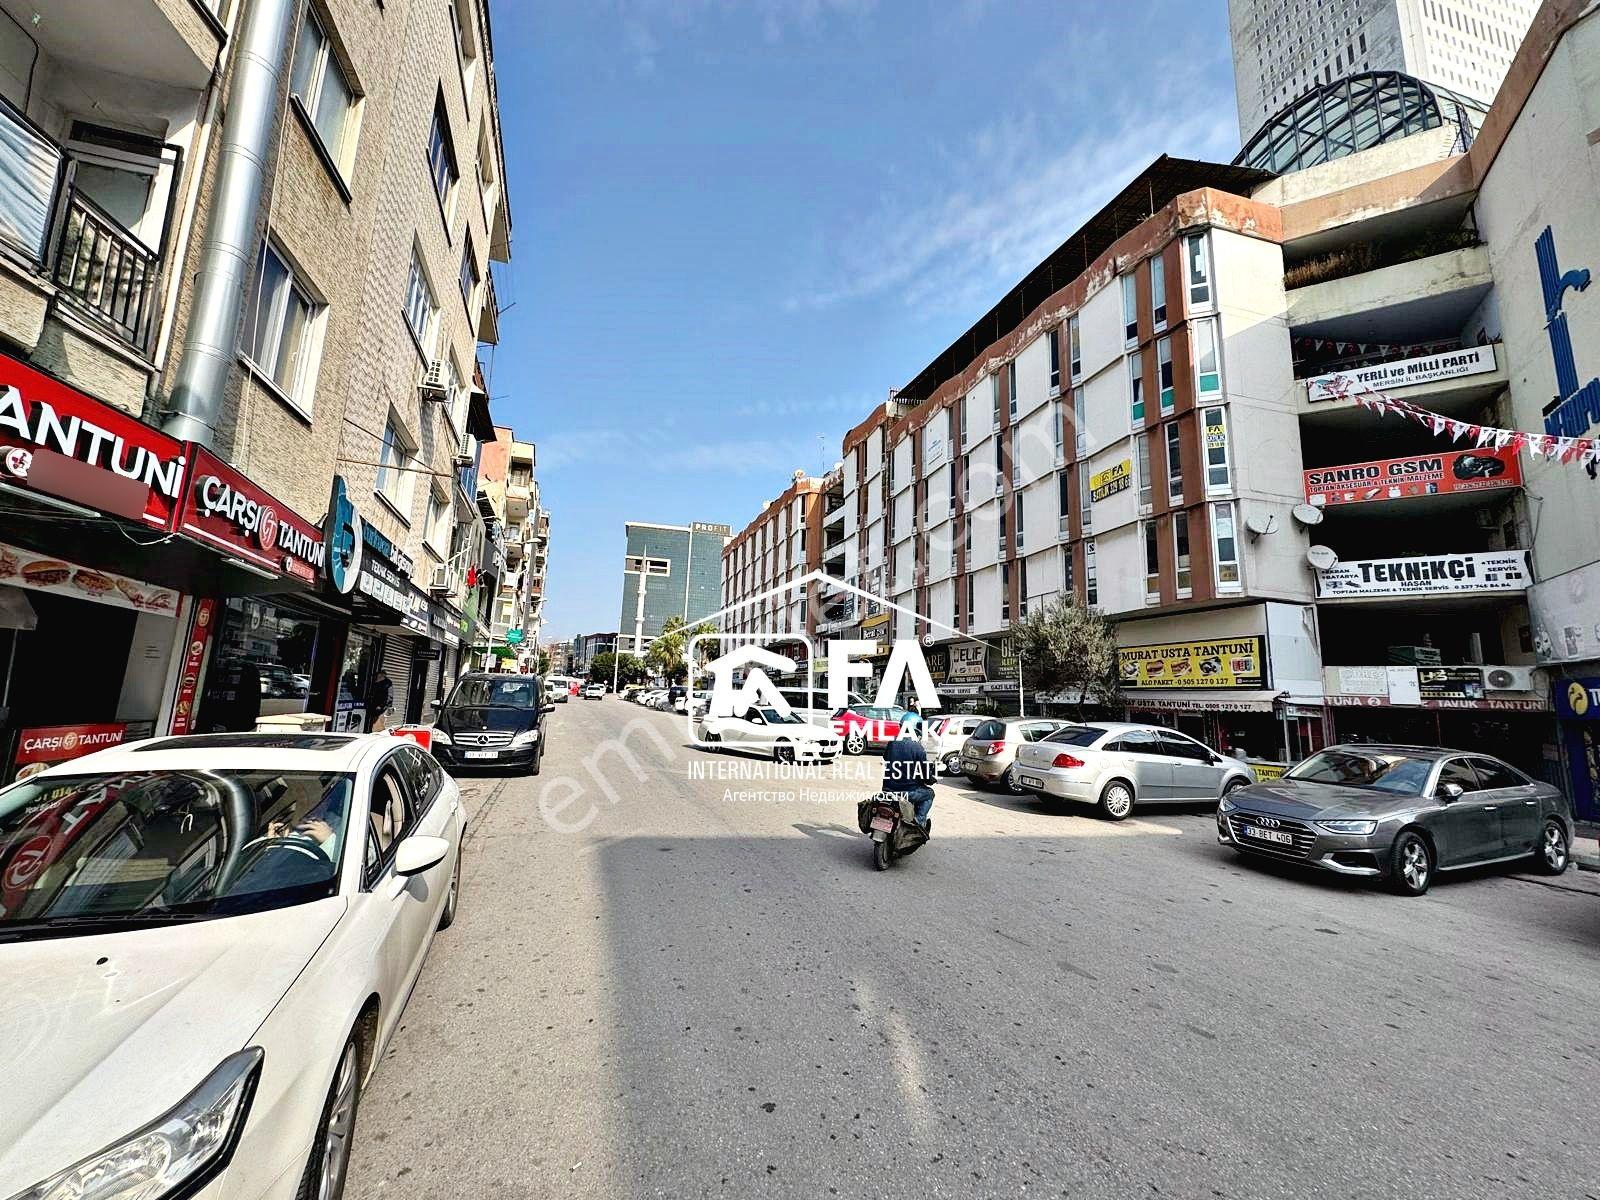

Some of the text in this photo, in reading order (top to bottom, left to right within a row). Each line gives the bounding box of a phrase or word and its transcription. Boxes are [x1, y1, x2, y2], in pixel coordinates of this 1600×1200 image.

[1356, 351, 1480, 383] YERLİ ve MİLLİ PARTİ
[1372, 378, 1404, 388] MERSİN
[1308, 457, 1443, 485] SANRO GSM
[203, 476, 261, 537] ÇARŞI
[695, 523, 728, 532] PROFIT
[1121, 639, 1254, 661] MURAT USTA TANTUNİ
[1158, 700, 1191, 708] TANTUNİ
[1325, 697, 1362, 706] TUNA
[1437, 700, 1479, 709] TAVUK
[24, 736, 62, 754] ÇARŞI
[78, 729, 124, 745] TANTUNİ
